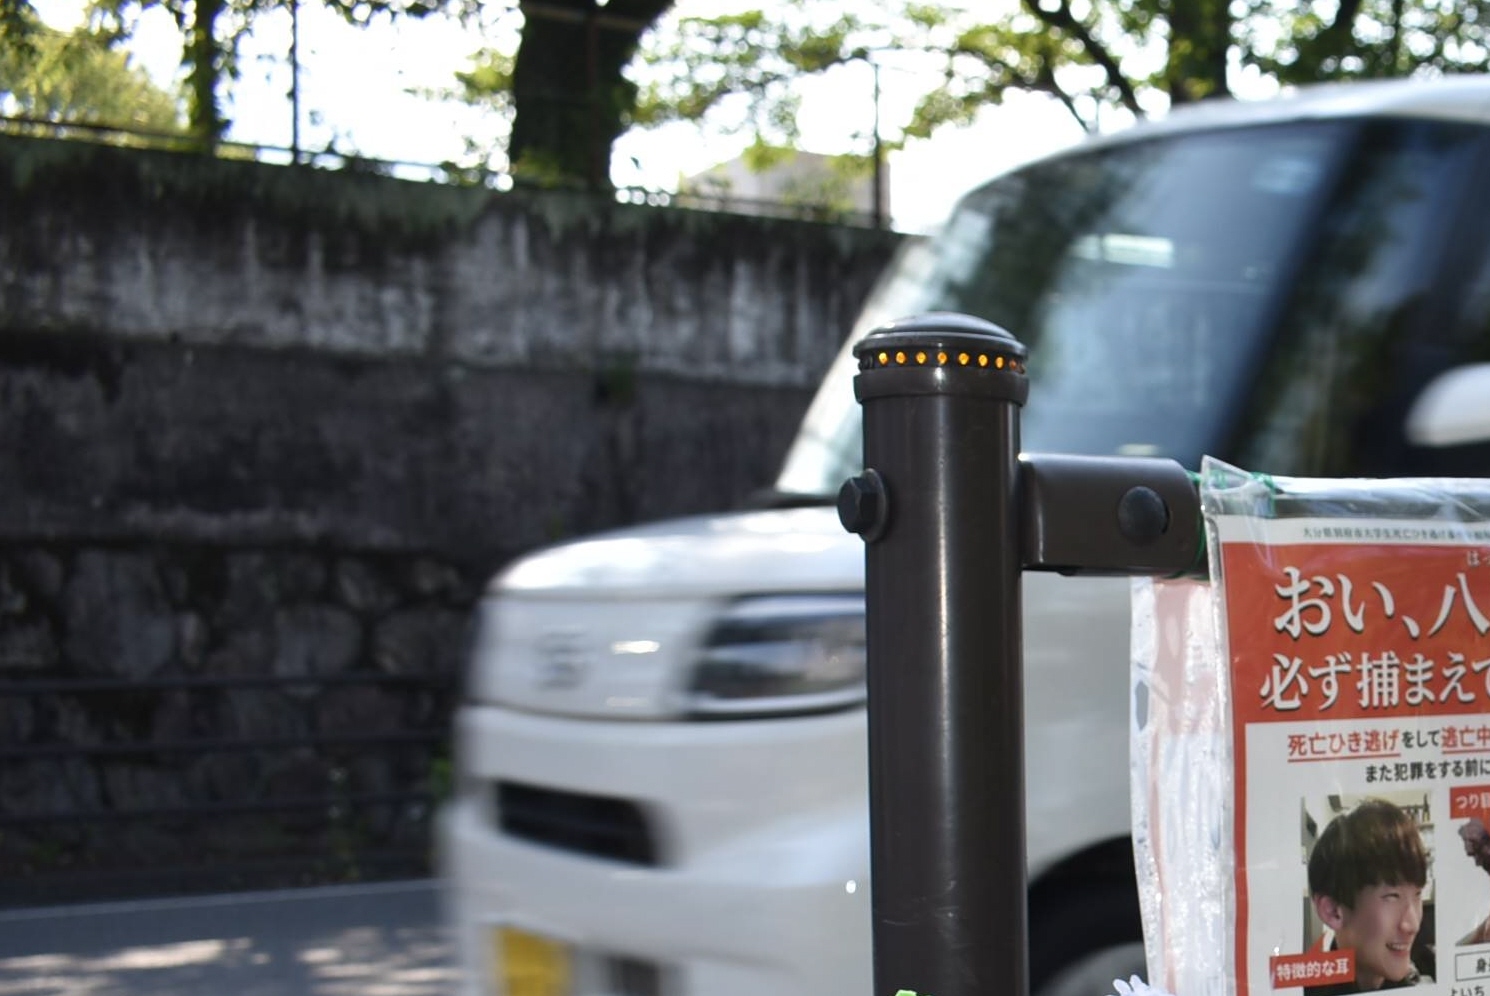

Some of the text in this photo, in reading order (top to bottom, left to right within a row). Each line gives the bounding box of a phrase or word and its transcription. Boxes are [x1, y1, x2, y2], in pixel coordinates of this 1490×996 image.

[1277, 958, 1349, 981] 特徴的な耳
